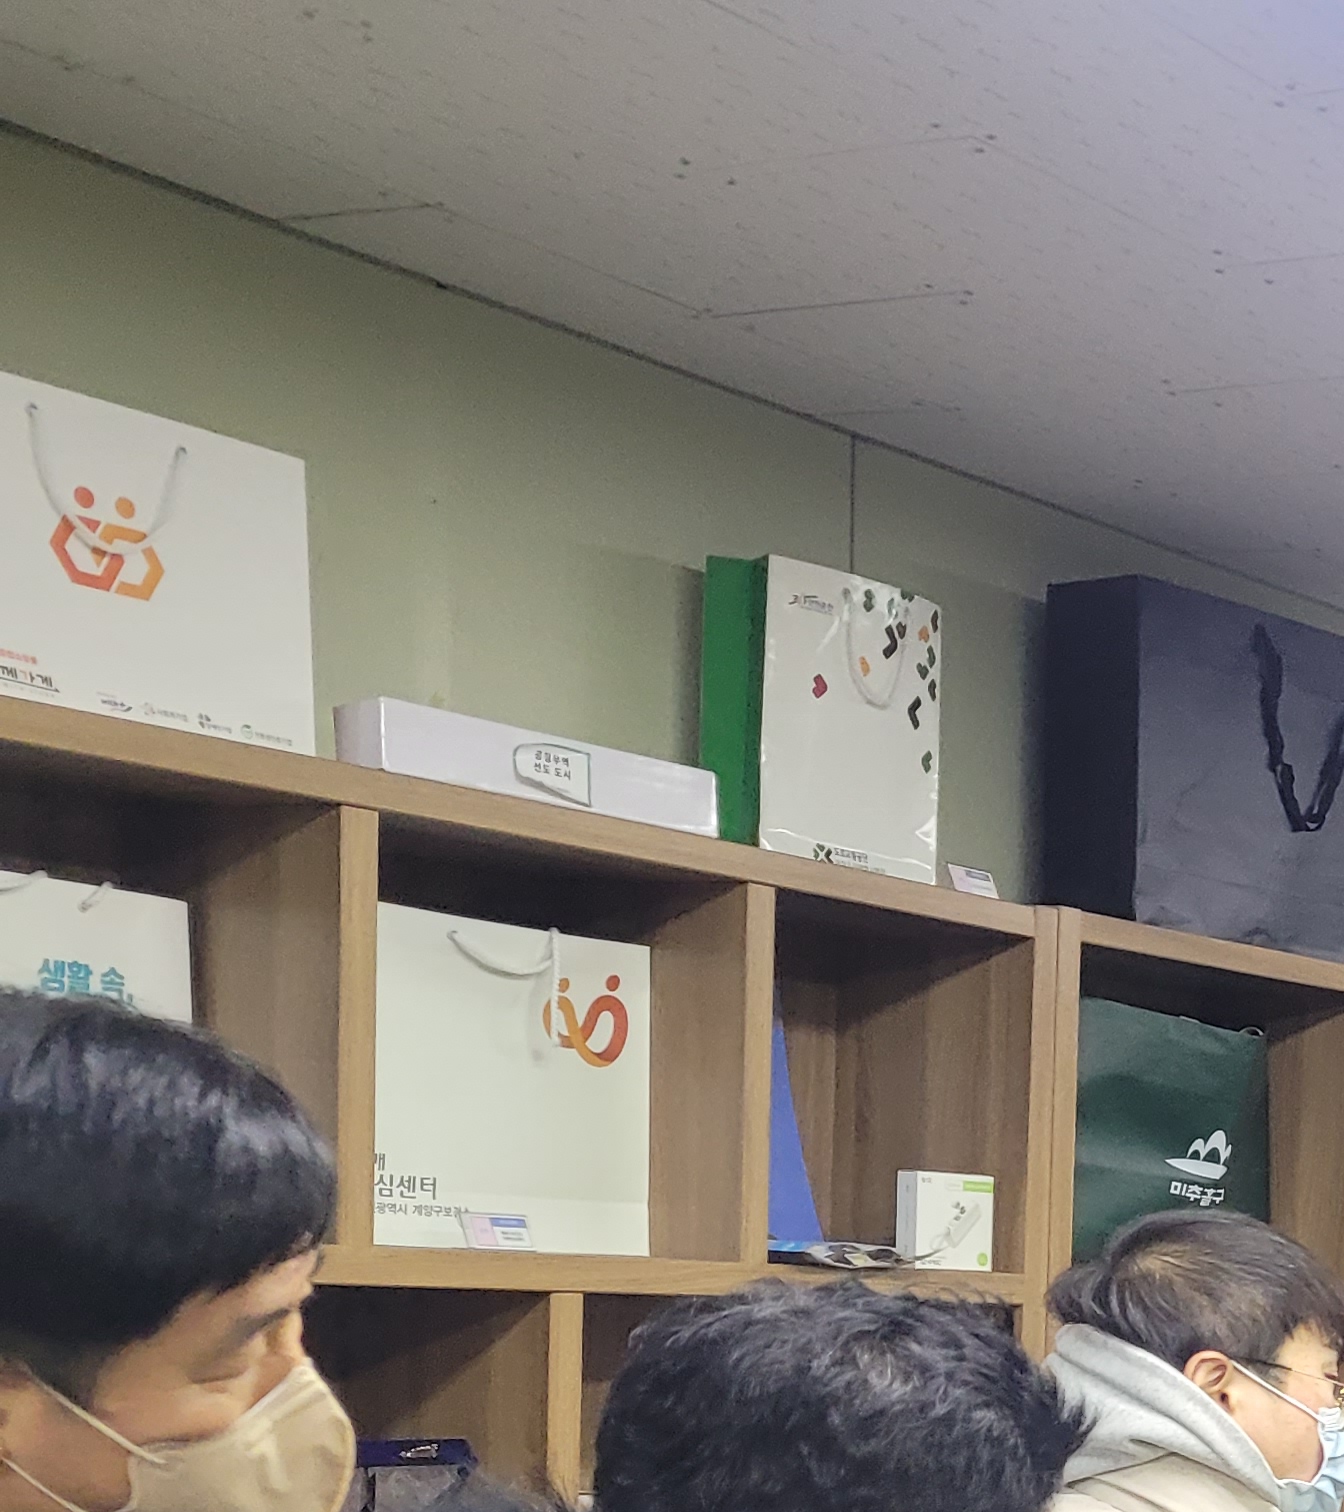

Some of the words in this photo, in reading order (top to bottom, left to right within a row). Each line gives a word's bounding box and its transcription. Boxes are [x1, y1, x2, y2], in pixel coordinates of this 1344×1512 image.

[534, 762, 550, 774] 선도
[554, 767, 571, 780] 도시
[38, 958, 93, 993] 생활
[1170, 1181, 1225, 1206] 미추홀구
[374, 1202, 408, 1215] 광역시
[412, 1204, 469, 1218] 계양구보건
